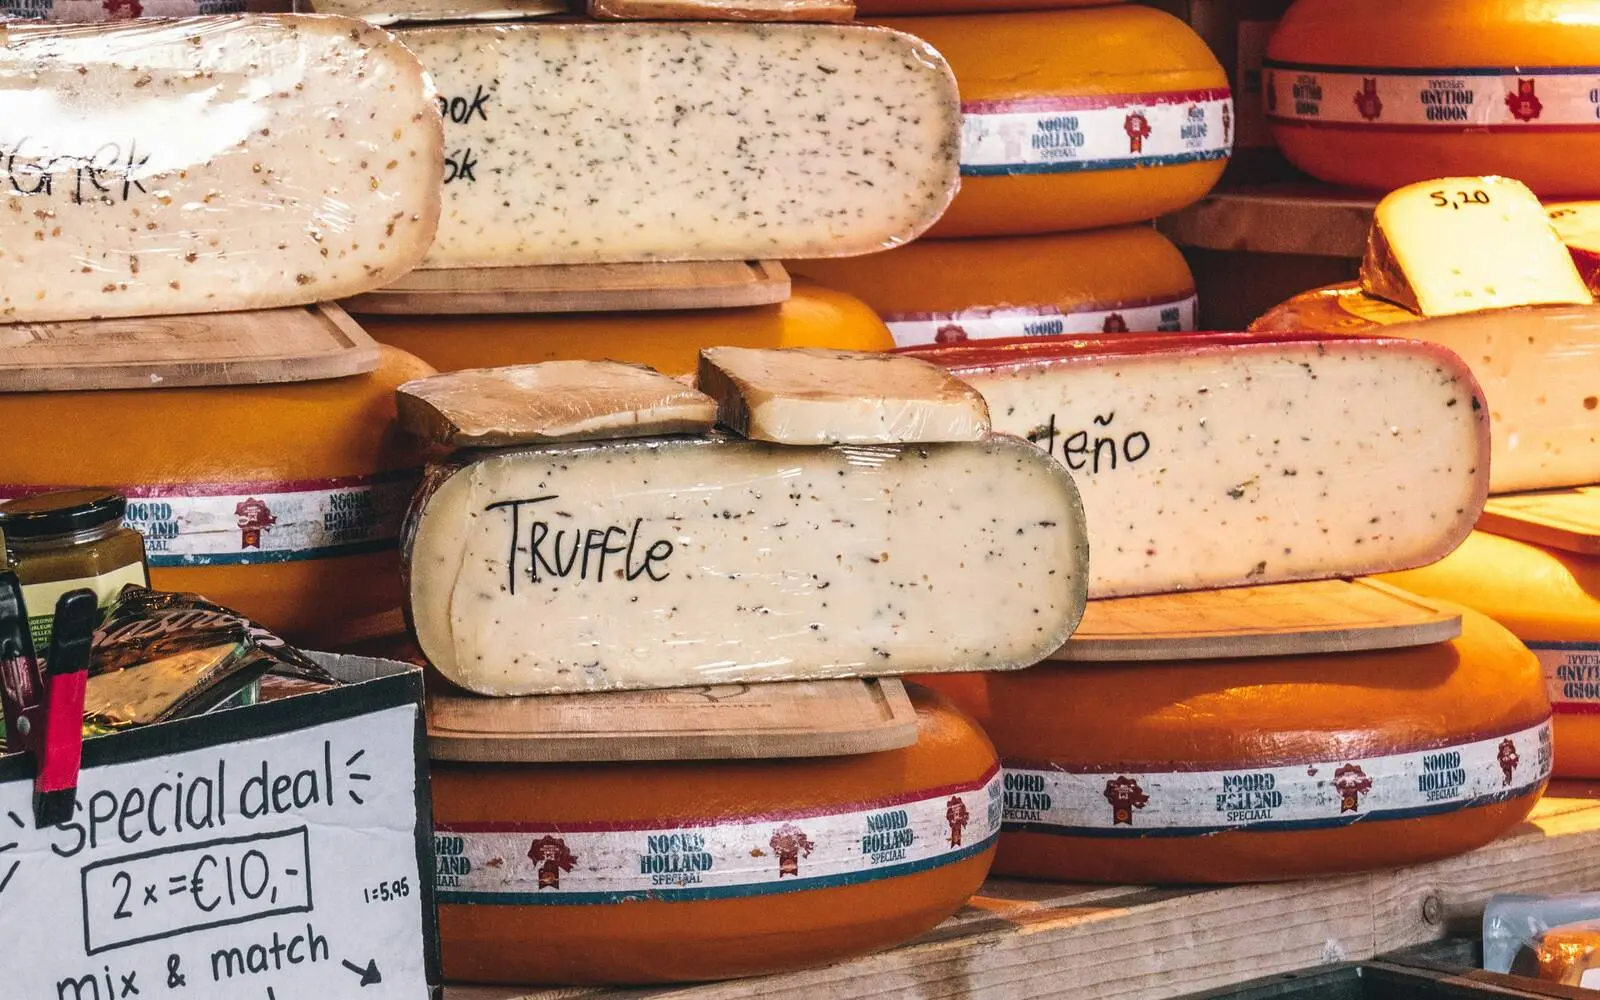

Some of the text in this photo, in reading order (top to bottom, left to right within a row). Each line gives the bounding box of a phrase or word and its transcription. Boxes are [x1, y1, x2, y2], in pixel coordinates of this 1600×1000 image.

[1430, 190, 1490, 210] 5,20
[124, 502, 172, 521] OORD
[1423, 751, 1461, 773] NOORD
[240, 740, 333, 819] deal
[1223, 773, 1275, 793] NOORD
[1418, 769, 1466, 792] HOLLAND
[1426, 787, 1459, 802] SPECIAAL
[866, 809, 908, 834] NOORD
[1227, 809, 1274, 822] SPECIAAL
[647, 833, 705, 854] NOORD
[862, 829, 914, 854] HOLLAND
[640, 853, 713, 874] HOLLAND
[871, 848, 906, 865] SPECIAAL
[652, 872, 703, 886] SPECIAAL
[112, 871, 132, 919] 2
[56, 923, 330, 1000] mix & match
